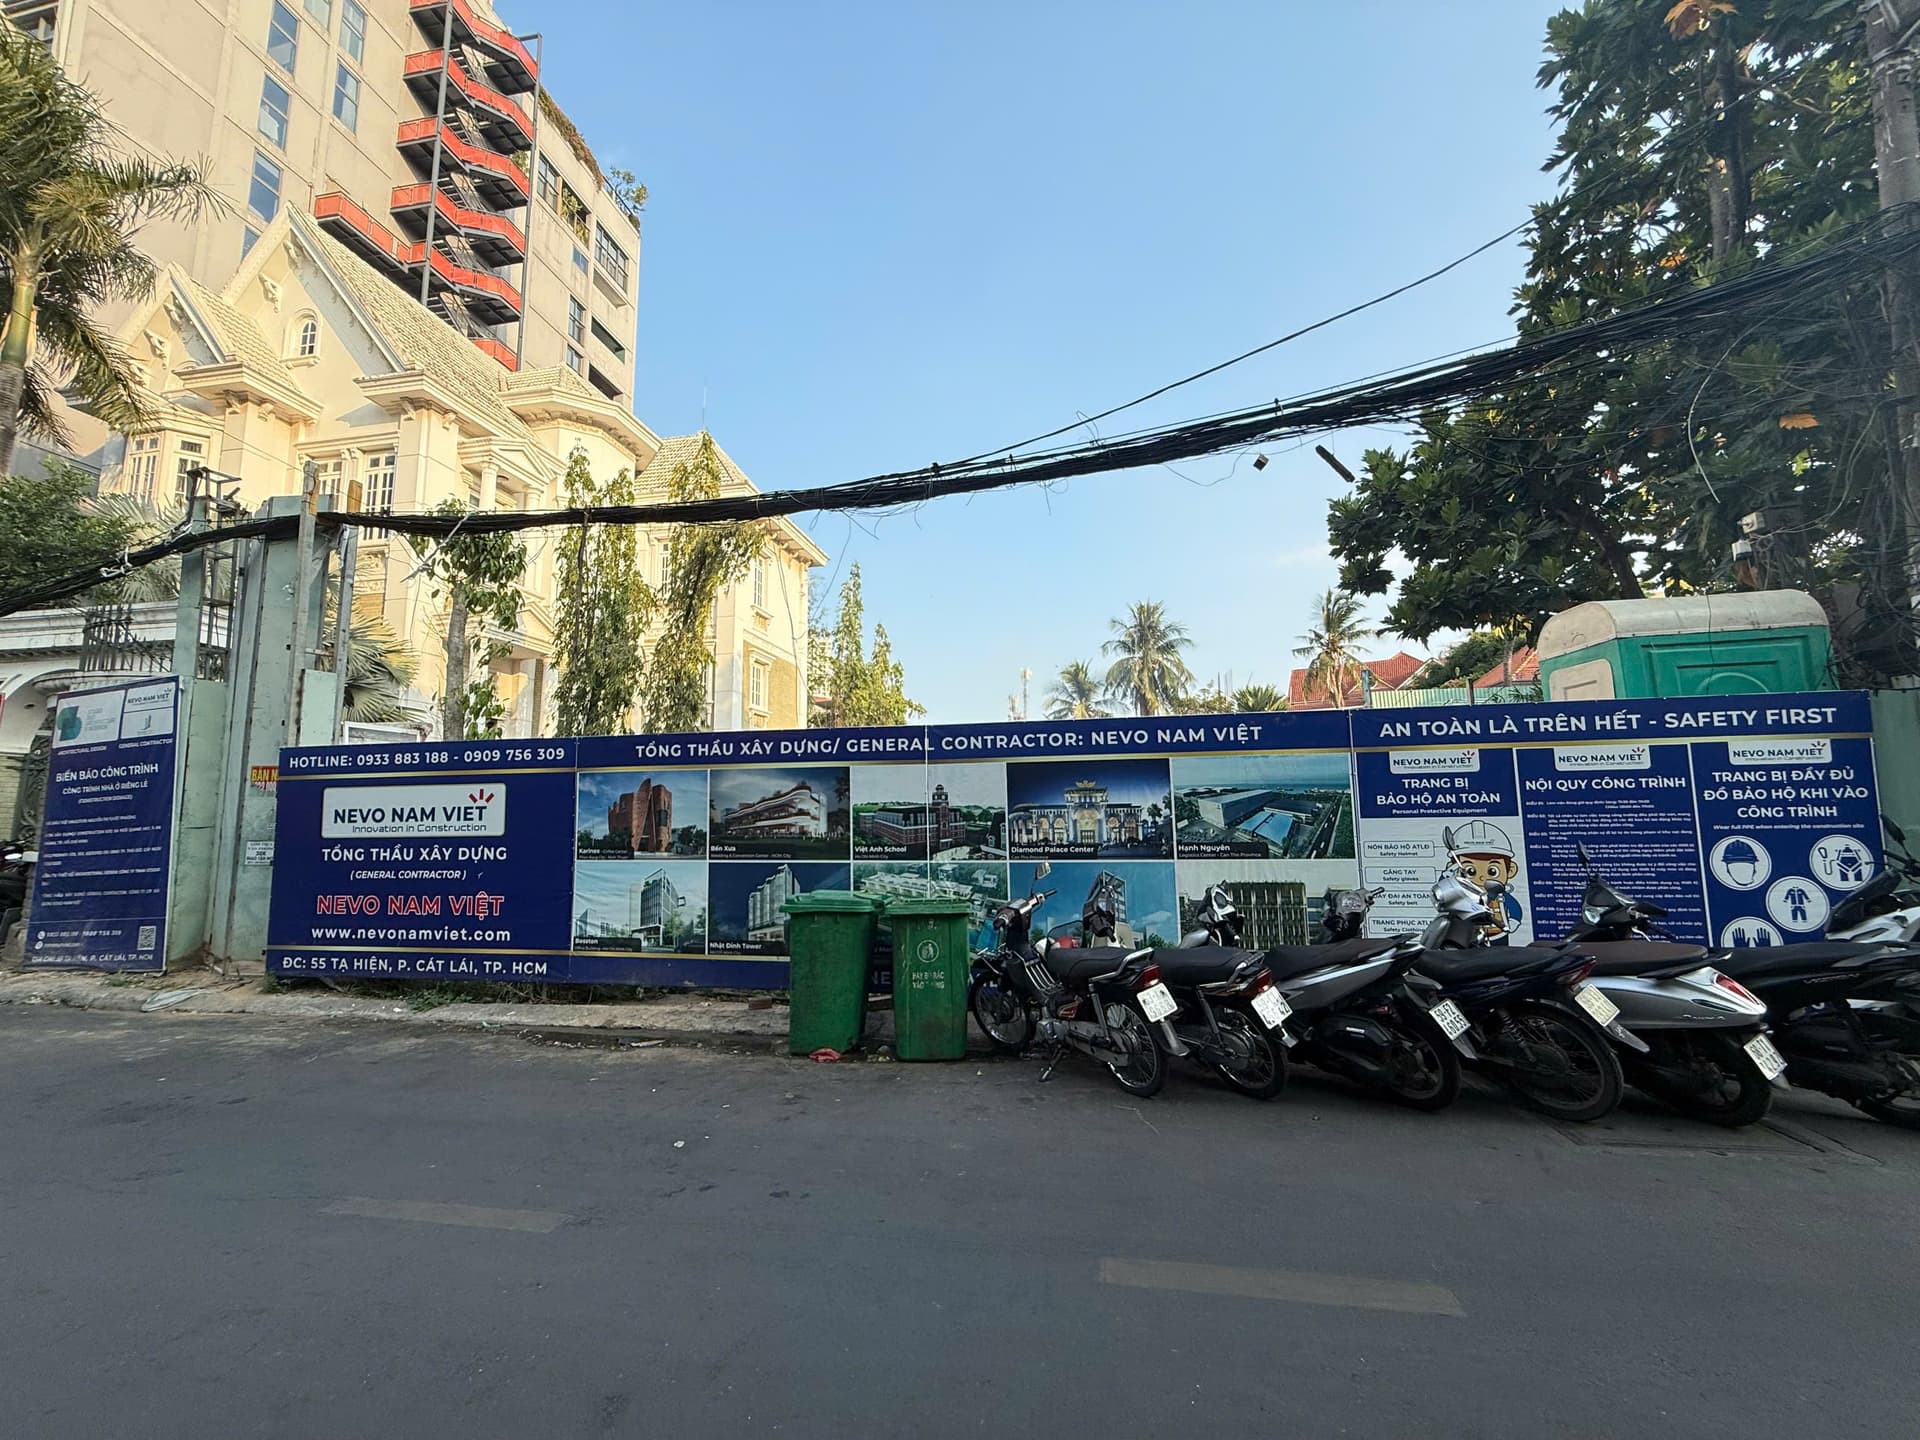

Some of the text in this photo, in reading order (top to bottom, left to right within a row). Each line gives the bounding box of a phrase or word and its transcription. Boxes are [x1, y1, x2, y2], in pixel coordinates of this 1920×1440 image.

[1379, 722, 1411, 738] AN
[1417, 716, 1481, 736] TOÀN
[1488, 715, 1519, 734] LÀ
[1524, 713, 1586, 733] TRÊN
[1595, 709, 1641, 730] HẾT
[1664, 710, 1758, 728] SAFETY
[1766, 707, 1837, 726] FIRST
[740, 739, 774, 756] XÂY
[846, 737, 935, 753] GENERAL
[941, 732, 1084, 750] CONTRACTOR:
[1091, 730, 1149, 746] NEVO
[1157, 728, 1205, 744] NAM
[1213, 723, 1262, 745] VIỆT
[289, 757, 352, 769] HOTLINE:
[357, 754, 390, 766] 0933
[394, 753, 420, 765] 883
[425, 752, 449, 764] 188
[464, 750, 500, 763] 0909
[506, 749, 532, 761] 756
[537, 747, 566, 760] 309
[1591, 754, 1618, 762] NAM
[1733, 748, 1823, 758] NEVO NAM VIET
[100, 766, 127, 778] CÔNG
[128, 762, 158, 775] TRÌNH
[1393, 758, 1421, 766] NEVO
[1525, 775, 1686, 792] NỘI QUY CÔNG TRÌNH
[1712, 771, 1766, 783] TRANG
[1771, 771, 1787, 784] BỊ
[1829, 766, 1855, 780] ĐỦ
[1402, 778, 1469, 790] TRANG BỊ
[1376, 791, 1500, 807] BẢO HỘ AN TOÀN
[1732, 786, 1767, 800] BẢO
[1771, 786, 1796, 802] HỘ
[1800, 788, 1828, 799] KHI
[1832, 785, 1868, 799] VÀO
[333, 805, 488, 824] NEVO NAM VIET
[1737, 804, 1838, 818] CÔNG TRÌNH
[352, 823, 487, 833] Innovation in Construction
[322, 844, 508, 864] TỔNG THẦU XÂY DỰNG
[316, 891, 505, 921] NEVO NAM VIỆT
[311, 926, 511, 942] www.nevonamviet.com
[282, 955, 548, 975] ĐC: 55 TẠ HIỆN, P. CÁT LÁI, TP. HCM
